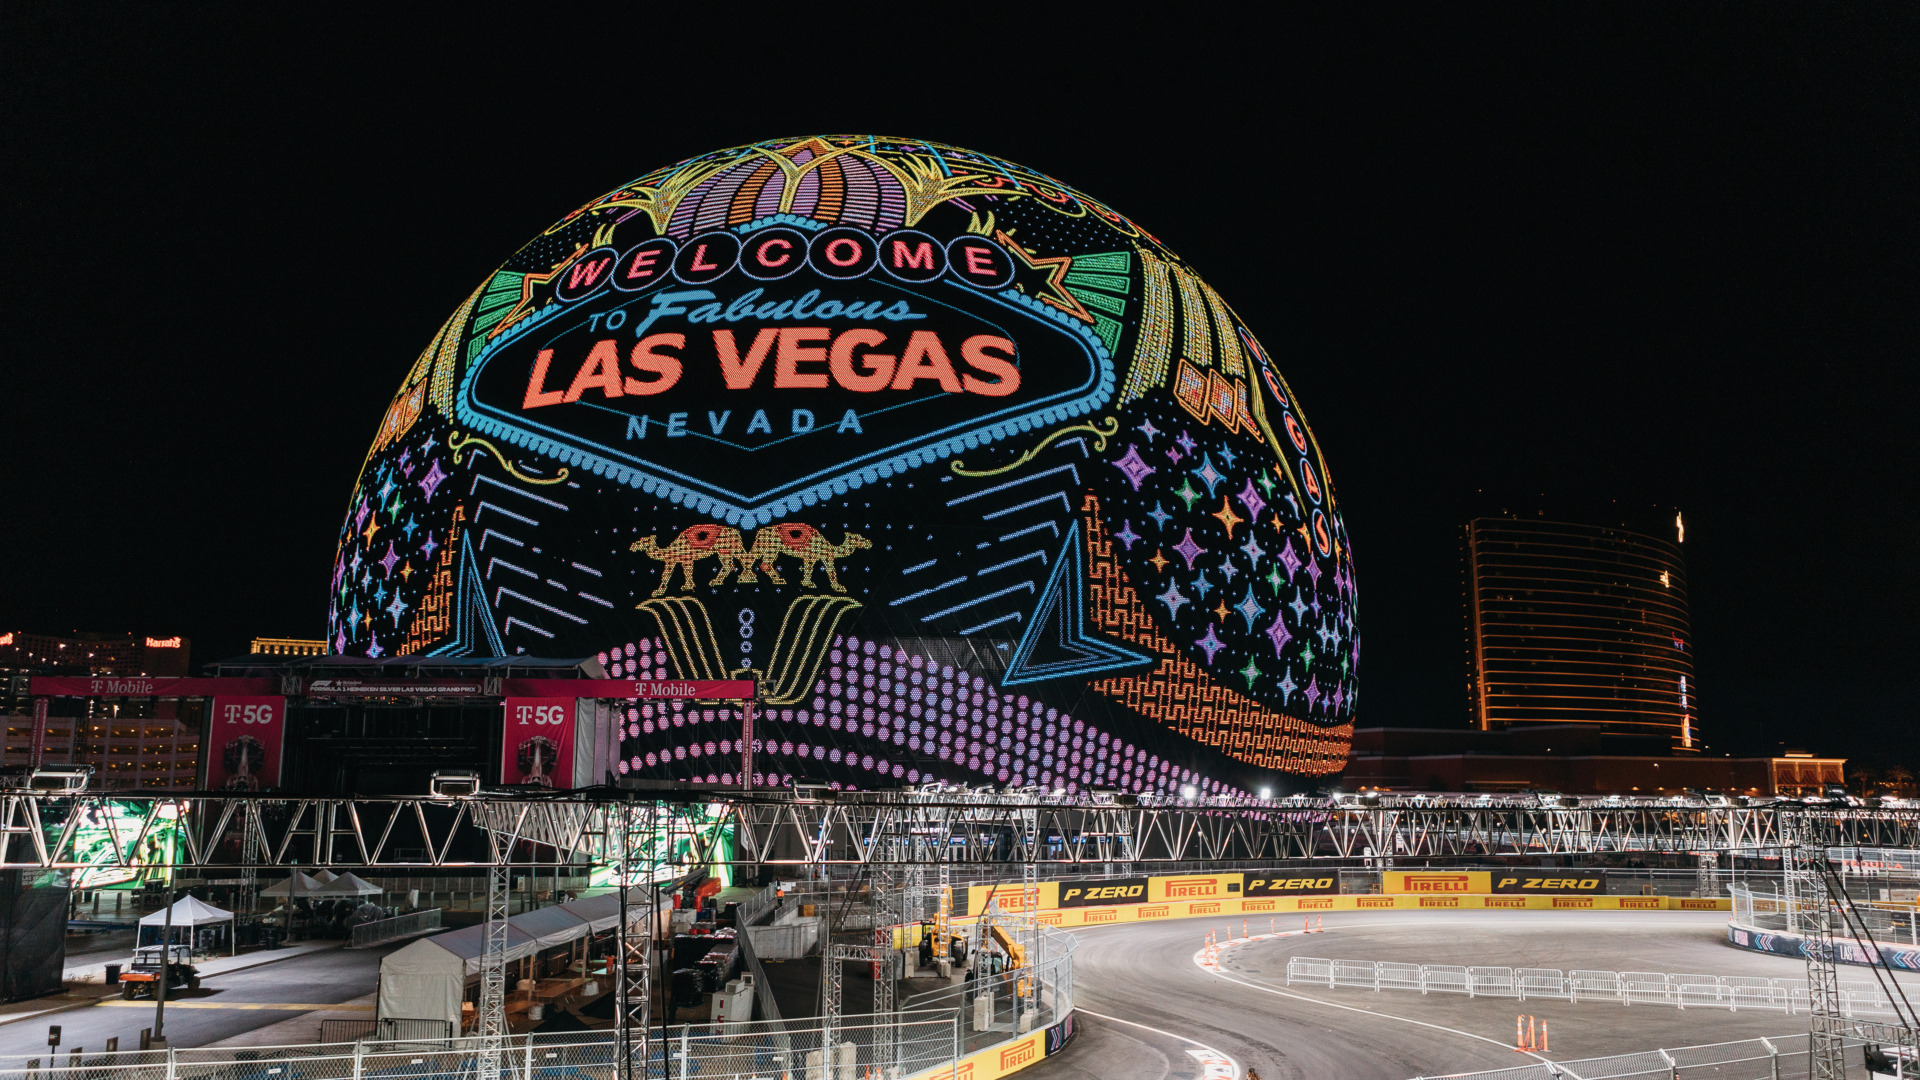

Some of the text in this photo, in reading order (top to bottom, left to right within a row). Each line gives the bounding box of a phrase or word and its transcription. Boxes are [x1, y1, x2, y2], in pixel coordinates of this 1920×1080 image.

[565, 238, 998, 292] WELCOME
[589, 289, 928, 337] TO Fabulous
[522, 326, 1023, 410] LAS VEGAS
[625, 408, 864, 441] NEVADA
[146, 636, 182, 649] Harrah's
[106, 680, 153, 694] Mobile
[650, 682, 696, 696] Mobile
[1165, 879, 1218, 897] PIRELLI
[1248, 878, 1334, 890] P ZERO
[1404, 876, 1468, 891] PIRELLI
[1497, 878, 1600, 890] P ZERO
[986, 887, 1041, 909] PRELLI
[1063, 885, 1144, 901] P ZERO
[1189, 902, 1221, 915] PIRELLI
[1241, 900, 1275, 911] PIRELLI
[1297, 898, 1333, 909] PIRELLI
[1357, 897, 1394, 908] PIRELLI
[1419, 897, 1459, 907] PIRELLI
[1484, 897, 1526, 908] PIRELLI
[1552, 898, 1593, 908] PIRELLI
[1620, 898, 1660, 908] PIRELLI
[1680, 900, 1717, 909] PIRELLI
[1084, 909, 1117, 922] PIRELLI
[1138, 905, 1170, 918] PIRELLI
[1029, 912, 1063, 926] PRELLI
[1000, 1039, 1035, 1071] PIRELLI
